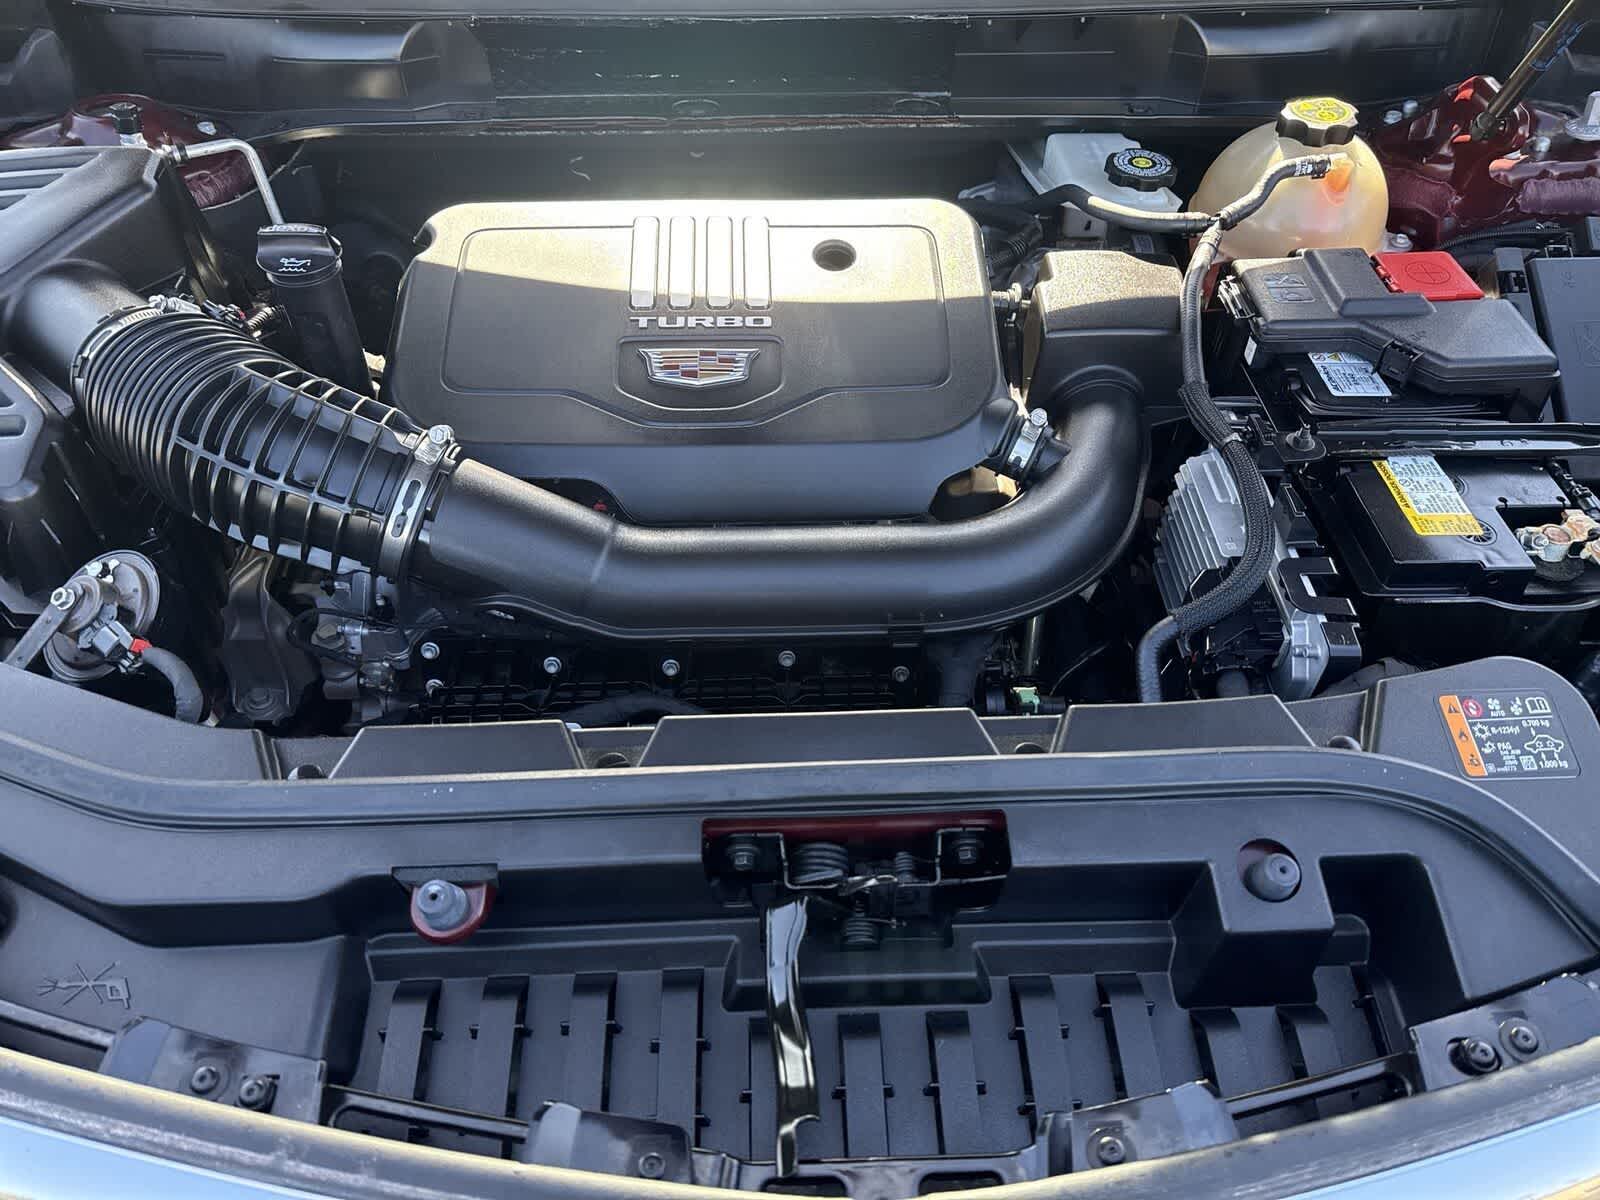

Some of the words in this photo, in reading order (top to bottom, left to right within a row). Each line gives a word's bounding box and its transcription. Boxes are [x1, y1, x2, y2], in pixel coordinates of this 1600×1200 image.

[629, 316, 772, 328] TURBO
[1541, 719, 1550, 728] kg
[1490, 725, 1520, 735] R-1234yf
[1497, 742, 1512, 750] PAG
[1559, 760, 1569, 769] kg
